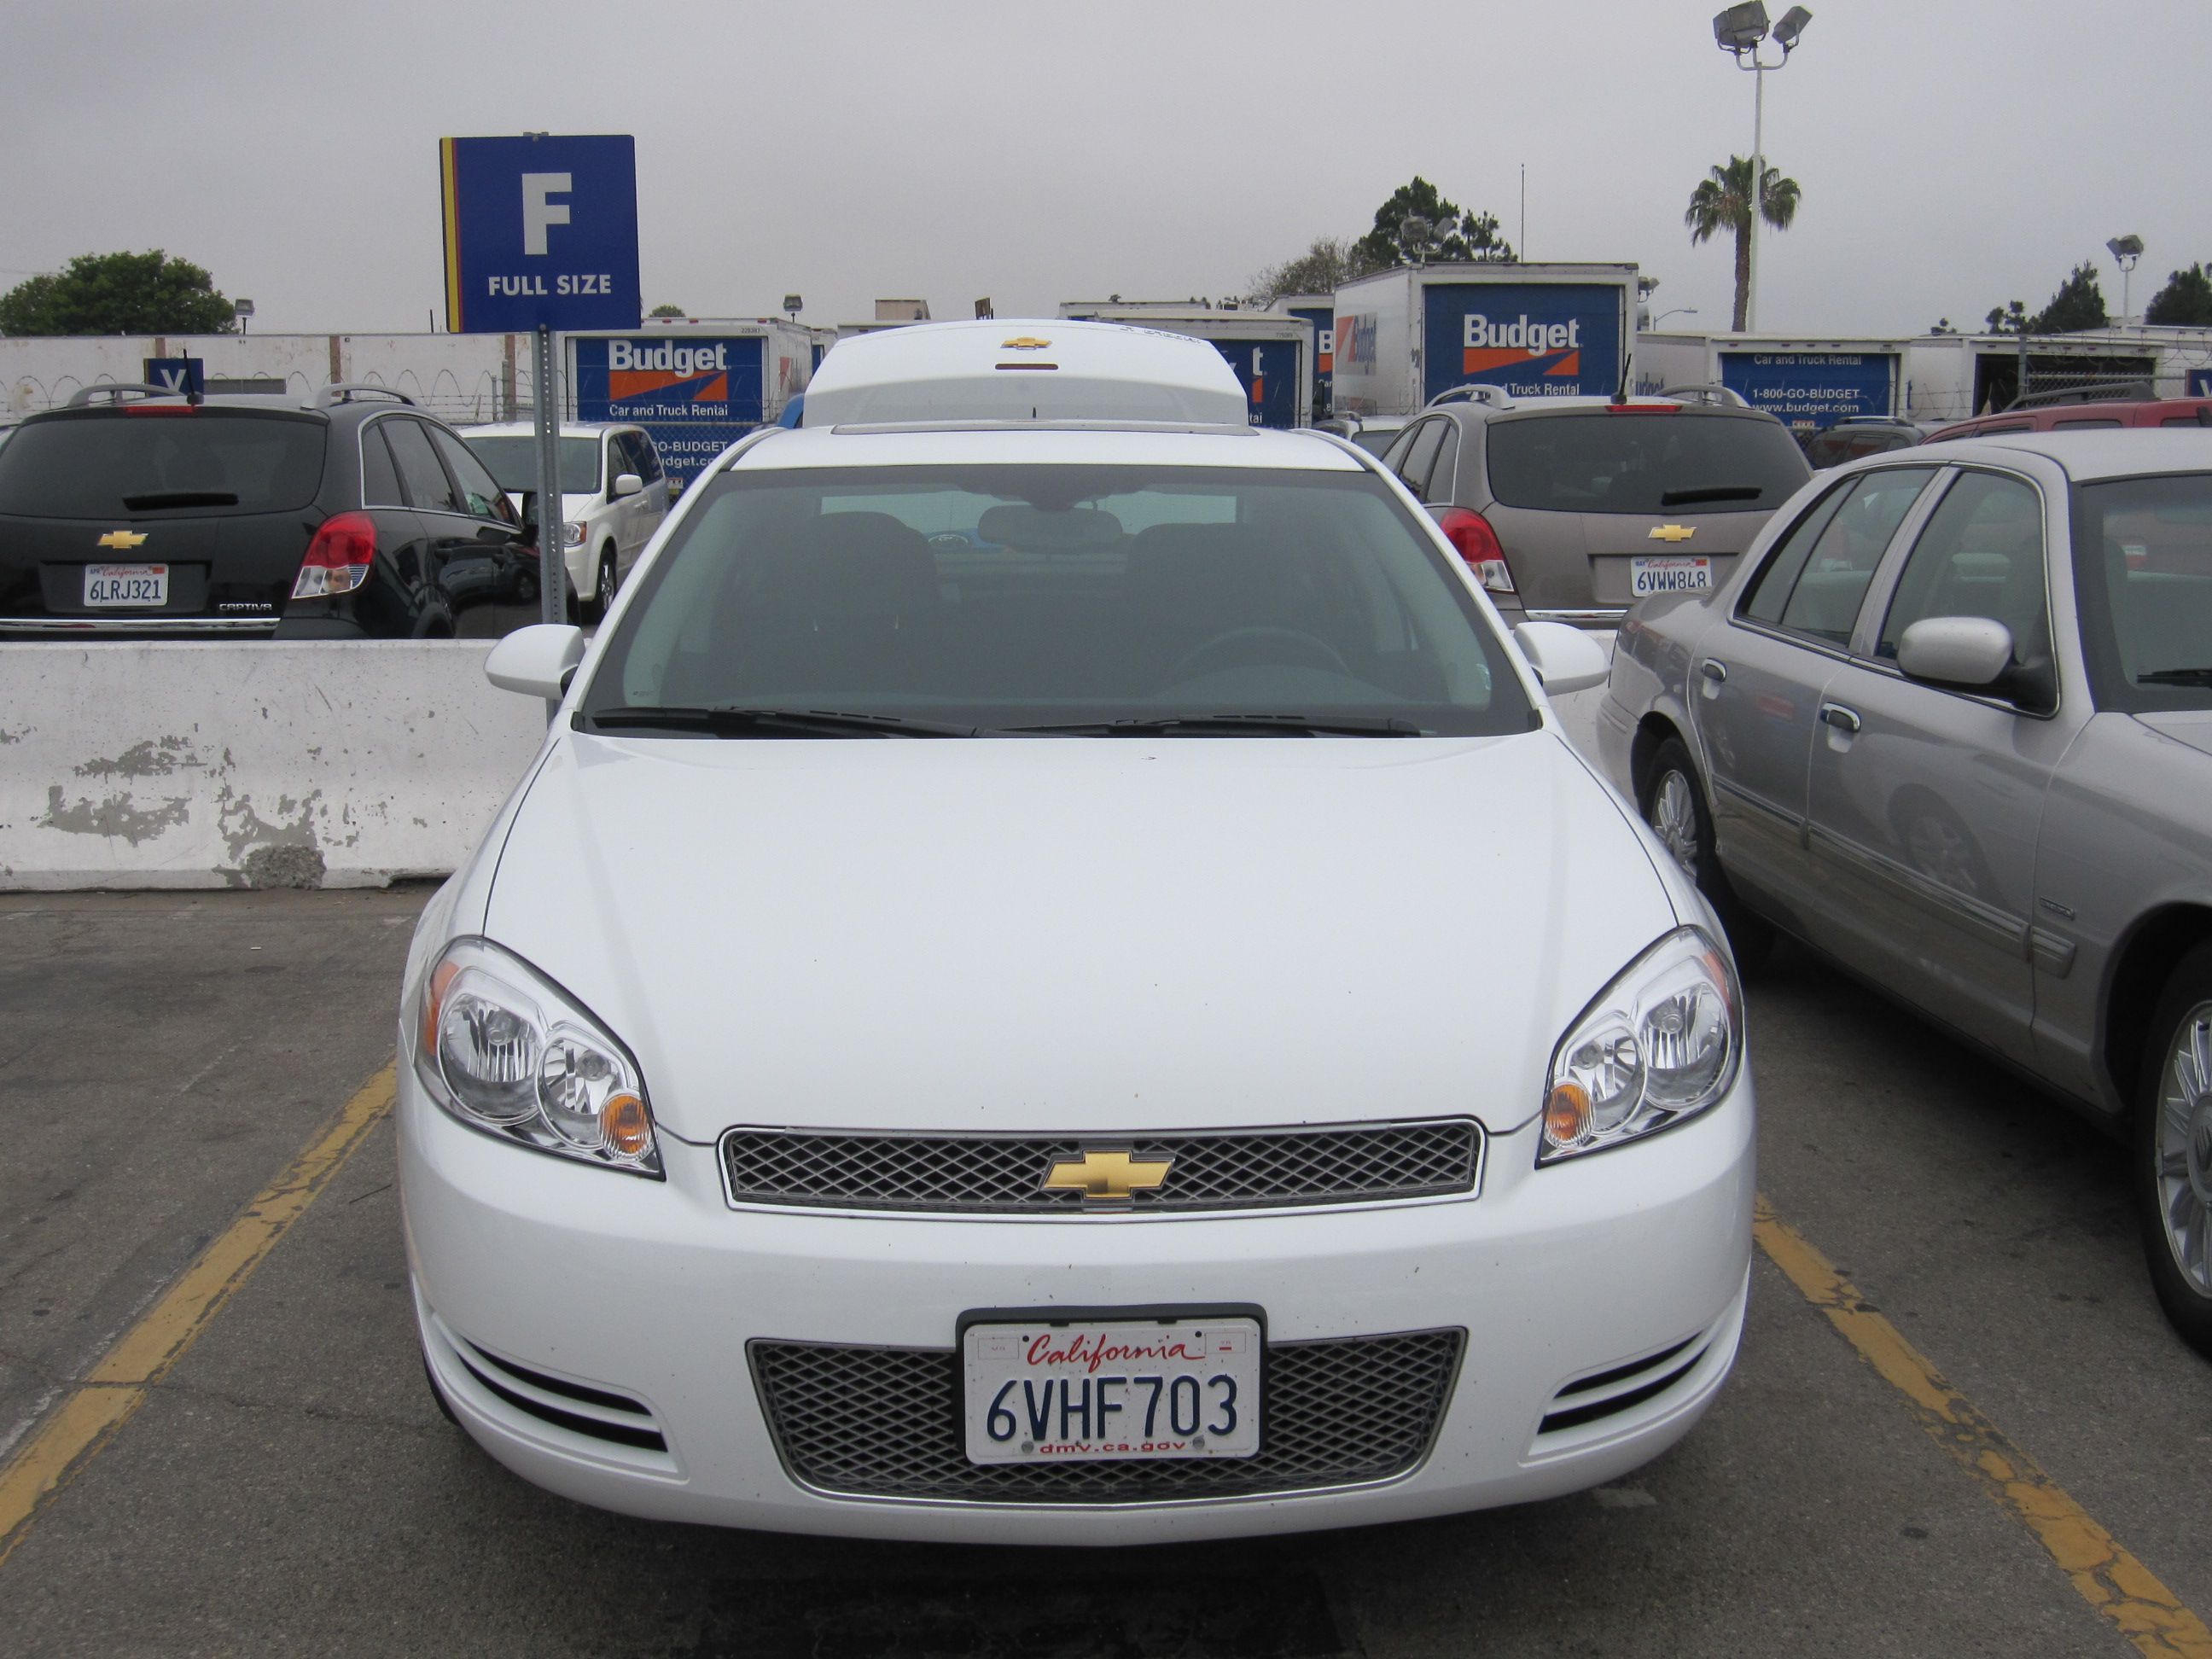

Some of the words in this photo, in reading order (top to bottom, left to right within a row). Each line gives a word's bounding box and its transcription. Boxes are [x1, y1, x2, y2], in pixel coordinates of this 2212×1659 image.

[521, 172, 573, 255] F
[488, 276, 548, 296] FULL
[556, 274, 611, 294] SIZE
[1464, 314, 1580, 357] Budget
[608, 340, 727, 378] Budget
[1754, 354, 1773, 365] Car
[1776, 354, 1795, 365] and
[1798, 354, 1826, 365] Truck
[1829, 354, 1861, 365] Rental
[160, 369, 187, 392] V
[1510, 383, 1541, 395] Truck
[1544, 383, 1580, 395] Rental
[1753, 388, 1860, 399] 1-800-GO-BUDGET
[609, 404, 629, 416] Car
[632, 404, 654, 416] and
[656, 404, 688, 416] Truck
[1752, 402, 1859, 415] www.budget.com
[103, 567, 153, 579] California
[1648, 559, 1696, 569] California
[90, 579, 161, 600] 6LRJ321
[1637, 571, 1707, 591] 6VWW848
[1027, 1334, 1205, 1373] California
[987, 1374, 1237, 1442] 6VHF703
[1039, 1441, 1186, 1453] dmv.ca.gov
